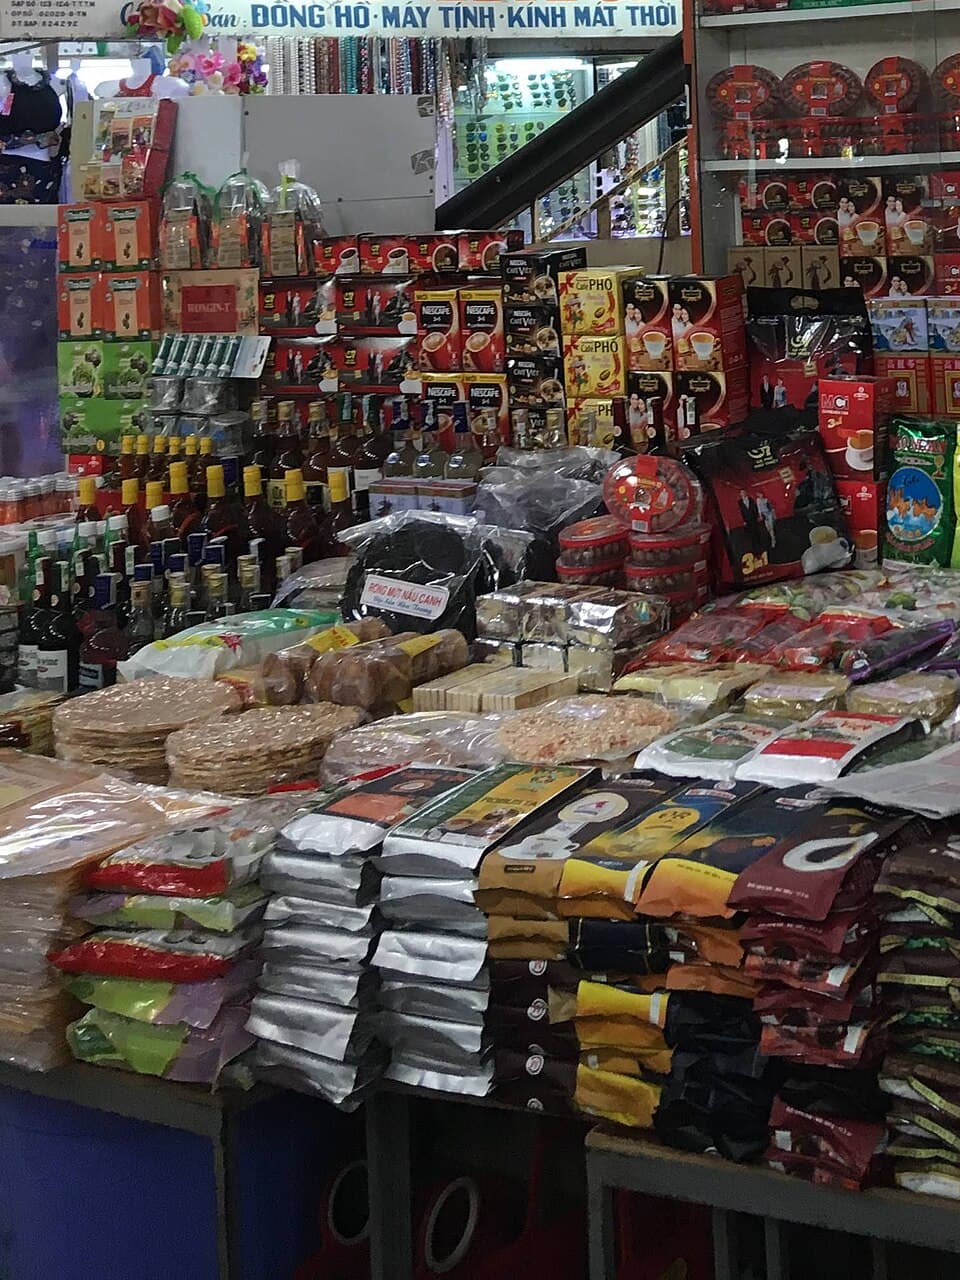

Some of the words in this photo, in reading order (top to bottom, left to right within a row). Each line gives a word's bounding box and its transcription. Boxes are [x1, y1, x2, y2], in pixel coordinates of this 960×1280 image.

[381, 1, 431, 28] MÁY
[438, 2, 495, 29] TÍNH
[507, 1, 566, 28] KÍNH
[598, 404, 613, 416] PH
